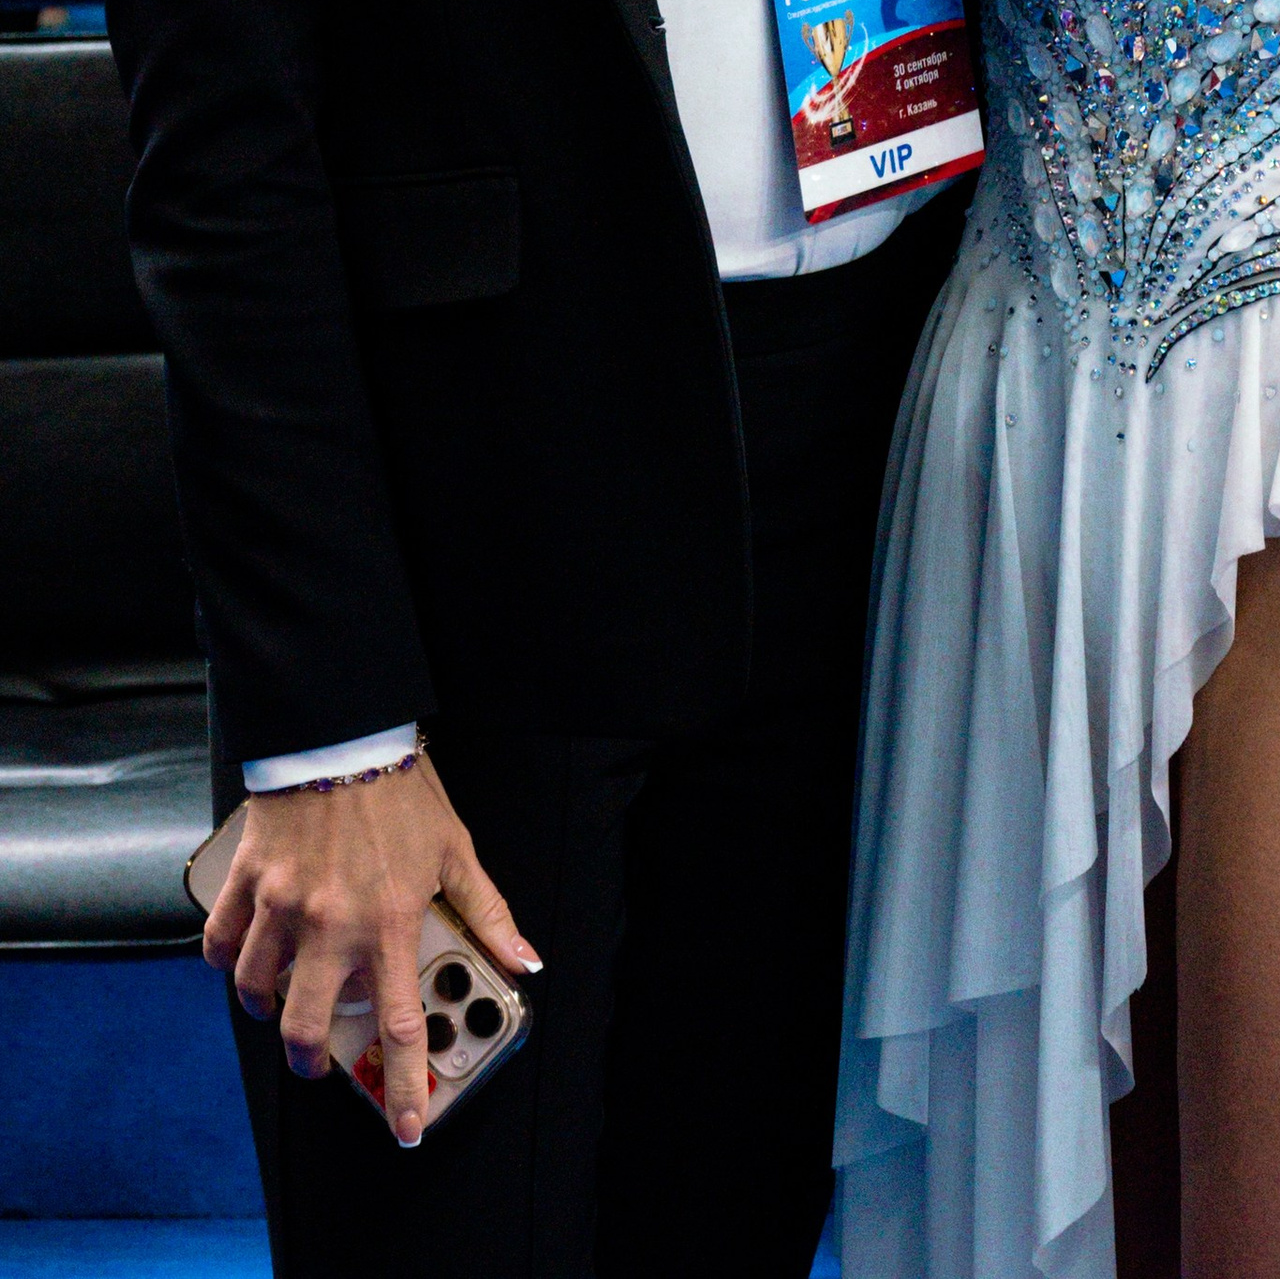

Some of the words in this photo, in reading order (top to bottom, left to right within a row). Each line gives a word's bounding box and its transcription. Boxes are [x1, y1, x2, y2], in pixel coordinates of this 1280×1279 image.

[893, 63, 905, 78] 30
[907, 51, 947, 72] сентября
[896, 79, 902, 92] 4
[904, 69, 939, 89] октября
[907, 99, 937, 116] Казань
[869, 143, 912, 178] VIP
